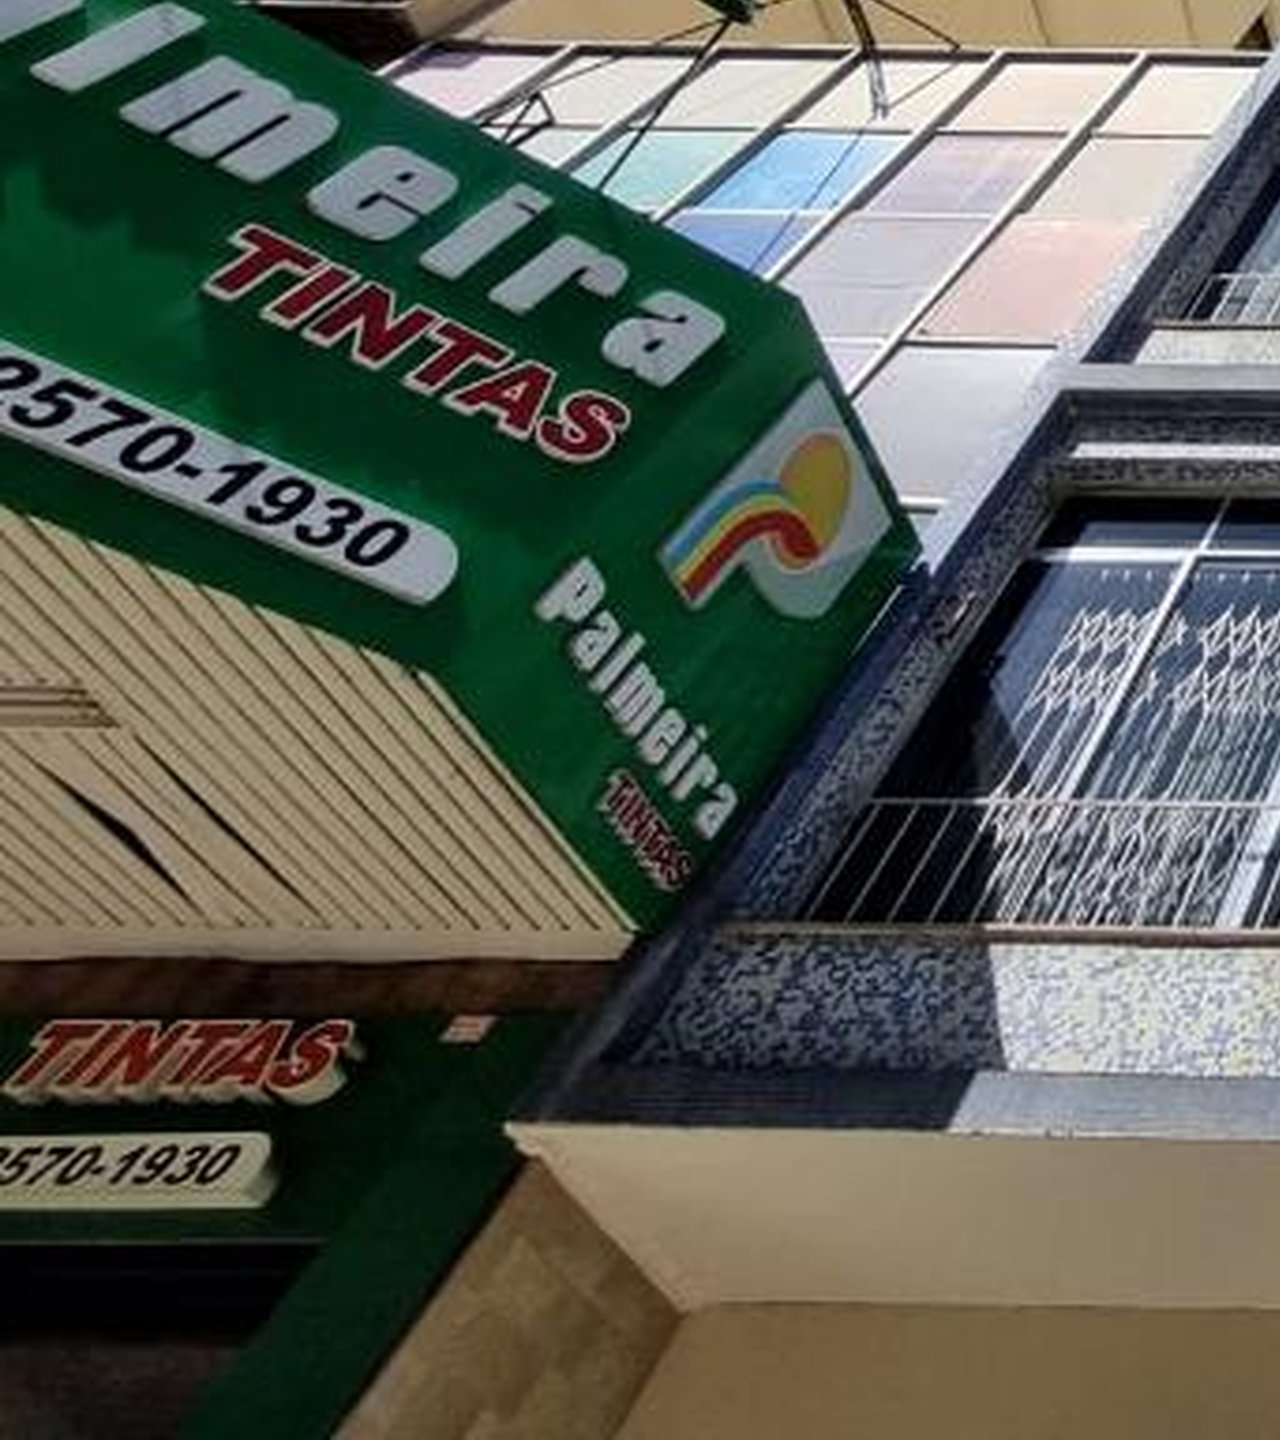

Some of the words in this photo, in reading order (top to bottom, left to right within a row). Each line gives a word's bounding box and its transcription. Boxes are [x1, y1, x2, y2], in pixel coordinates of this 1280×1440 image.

[202, 223, 632, 462] TINTAS
[534, 556, 738, 841] Palmeira
[597, 769, 692, 892] TINTAS
[2, 1019, 356, 1104] TINTAS
